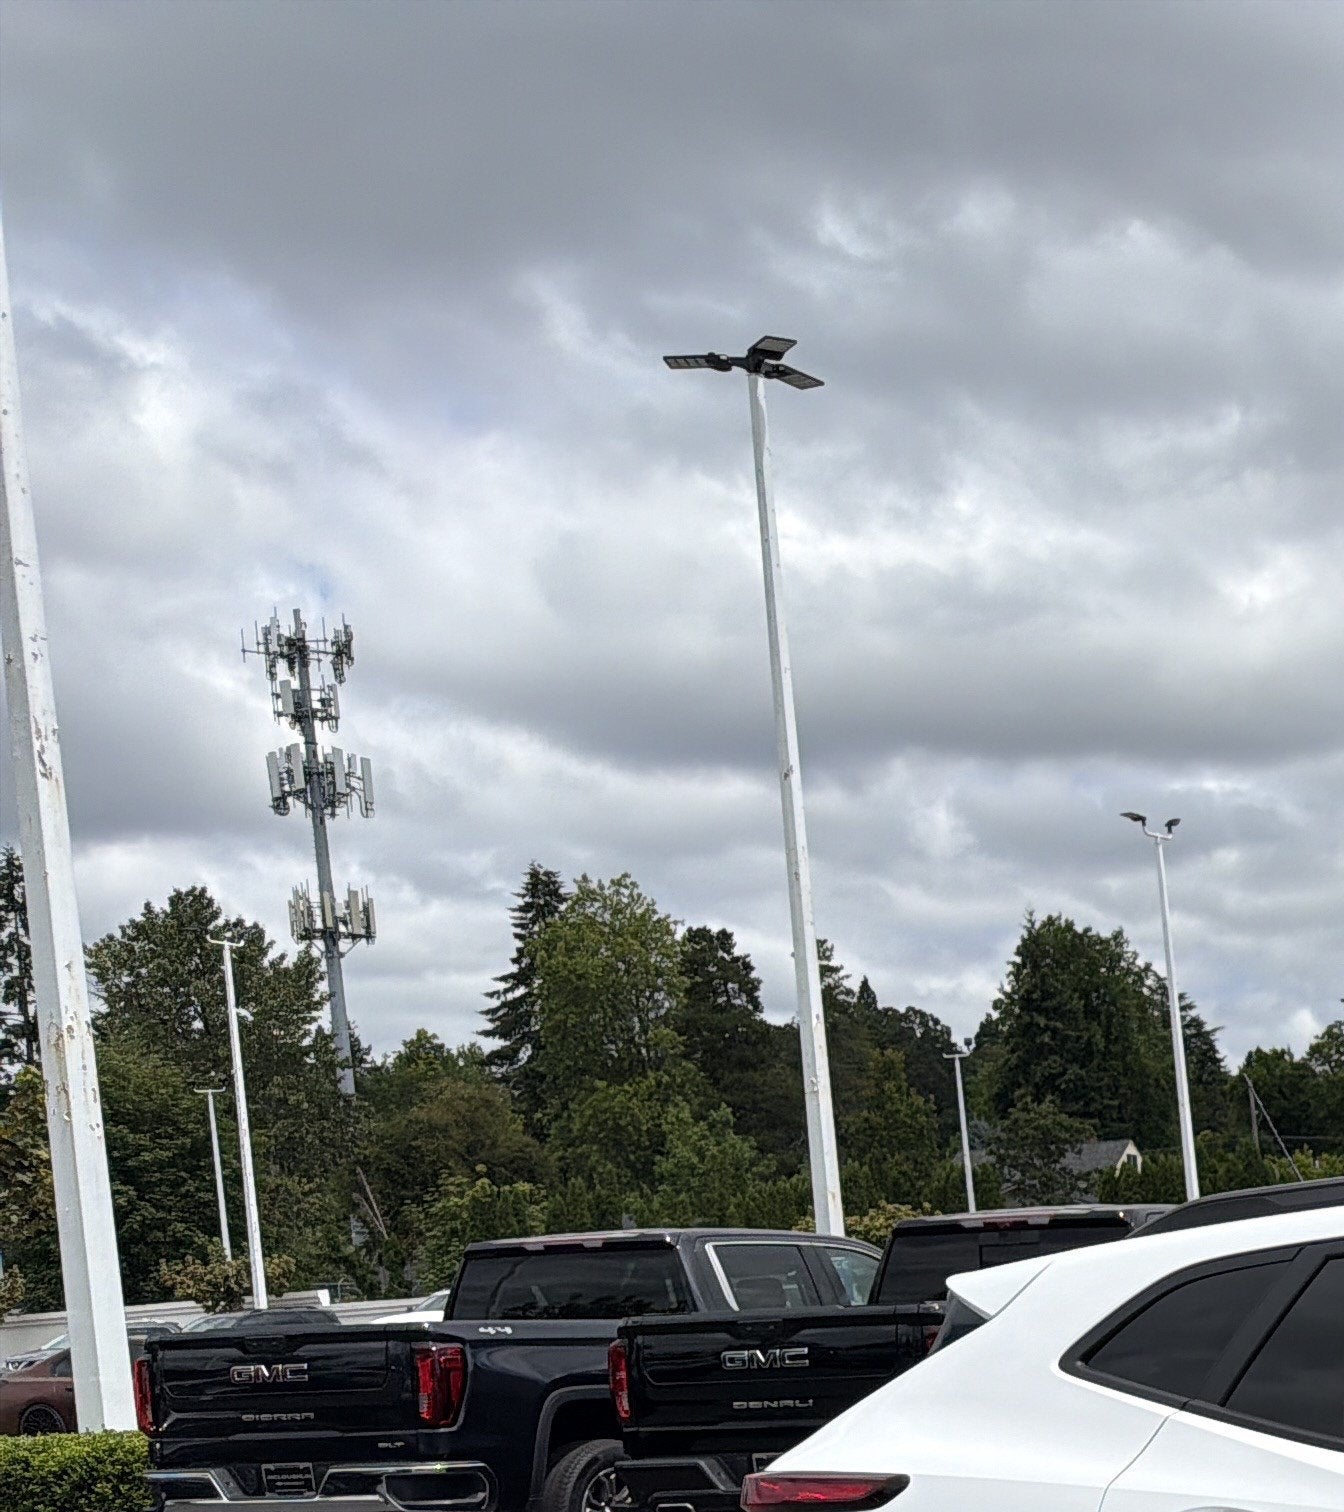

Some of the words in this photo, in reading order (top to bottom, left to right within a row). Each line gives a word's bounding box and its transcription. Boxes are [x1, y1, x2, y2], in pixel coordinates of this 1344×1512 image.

[720, 1347, 810, 1370] GMC
[229, 1362, 309, 1384] GMC
[732, 1399, 814, 1410] DENALI
